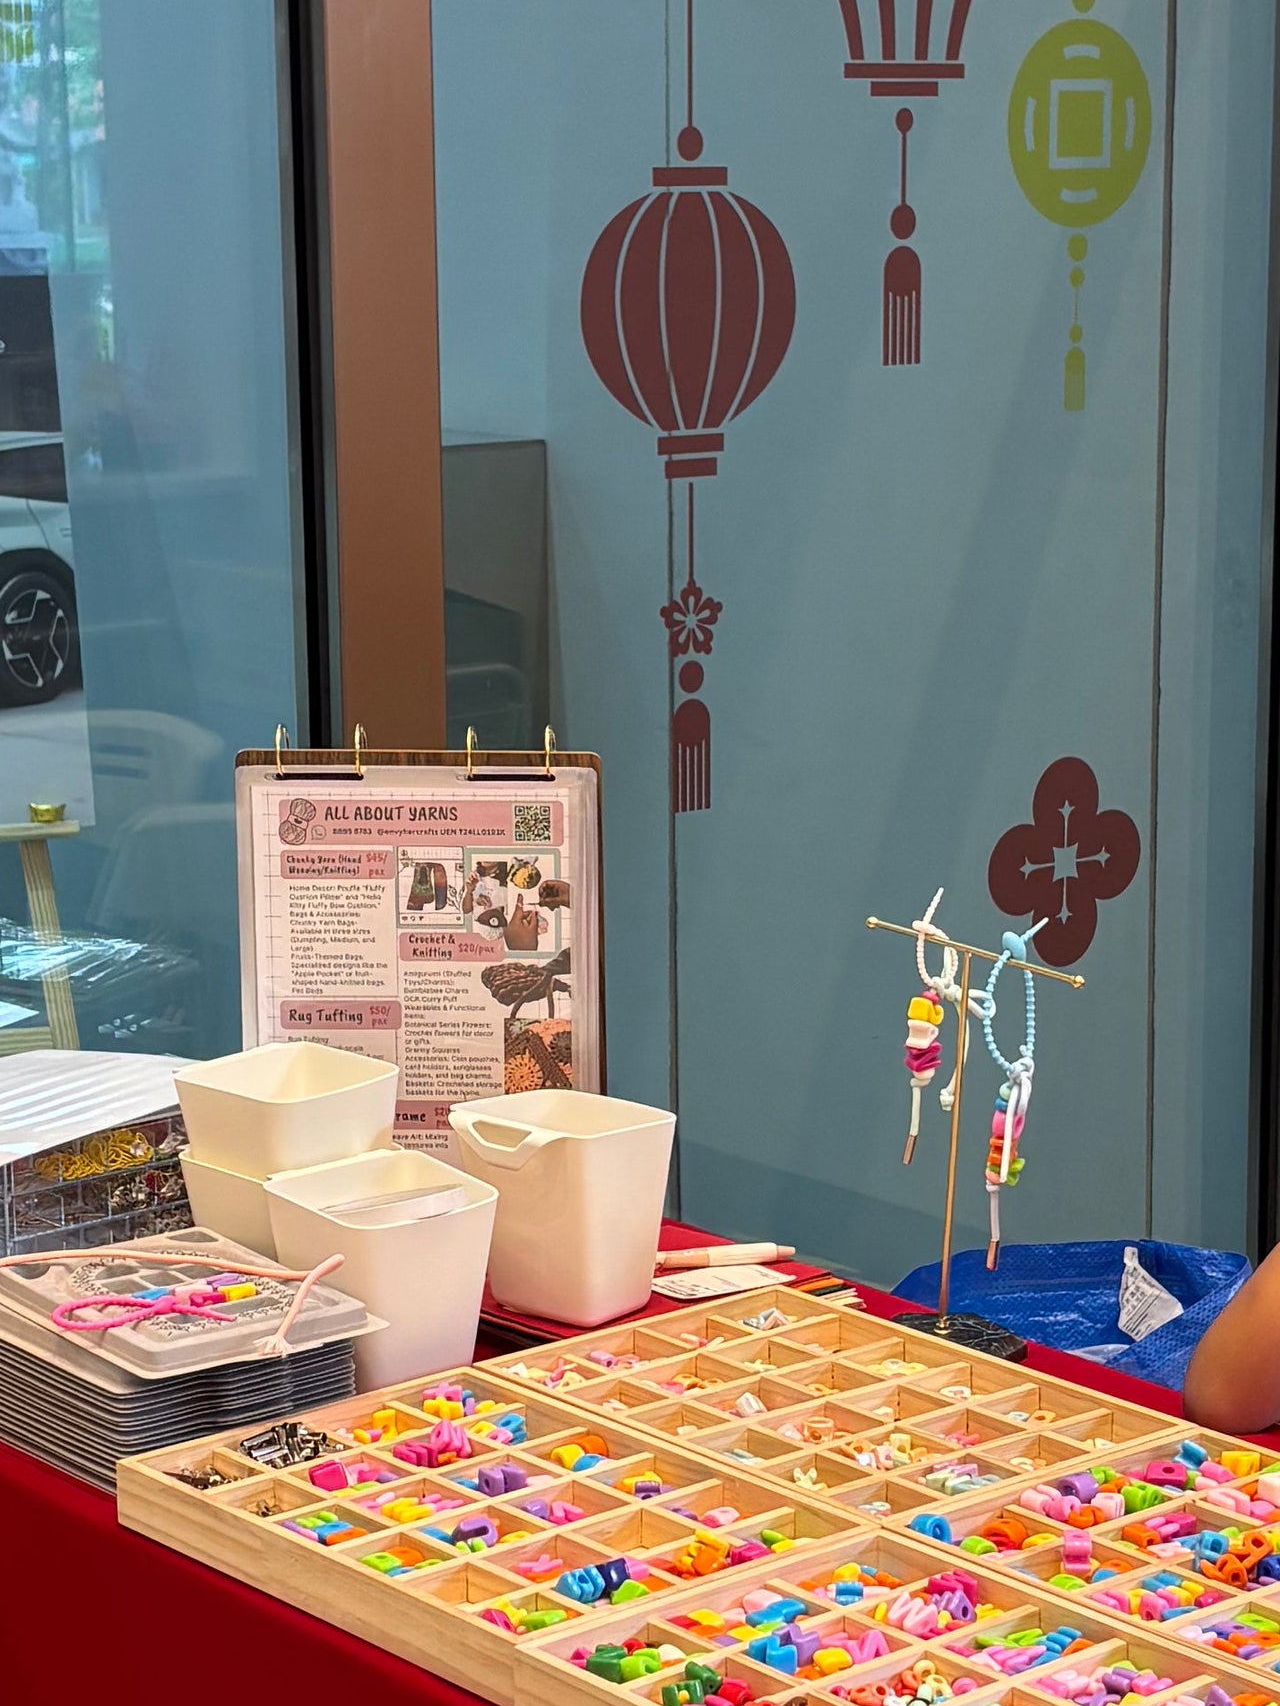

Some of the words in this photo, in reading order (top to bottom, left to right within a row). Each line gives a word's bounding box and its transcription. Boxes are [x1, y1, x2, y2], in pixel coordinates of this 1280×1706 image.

[325, 806, 349, 821] ALL
[354, 806, 405, 821] ABOUT
[408, 806, 458, 821] YARNS
[409, 934, 445, 944] Crochet
[448, 934, 455, 944] &
[412, 948, 452, 960] Knitting
[458, 943, 495, 956] $20/pax
[289, 1009, 312, 1024] Rug
[316, 1009, 363, 1024] Tufting
[370, 1006, 391, 1017] $50/
